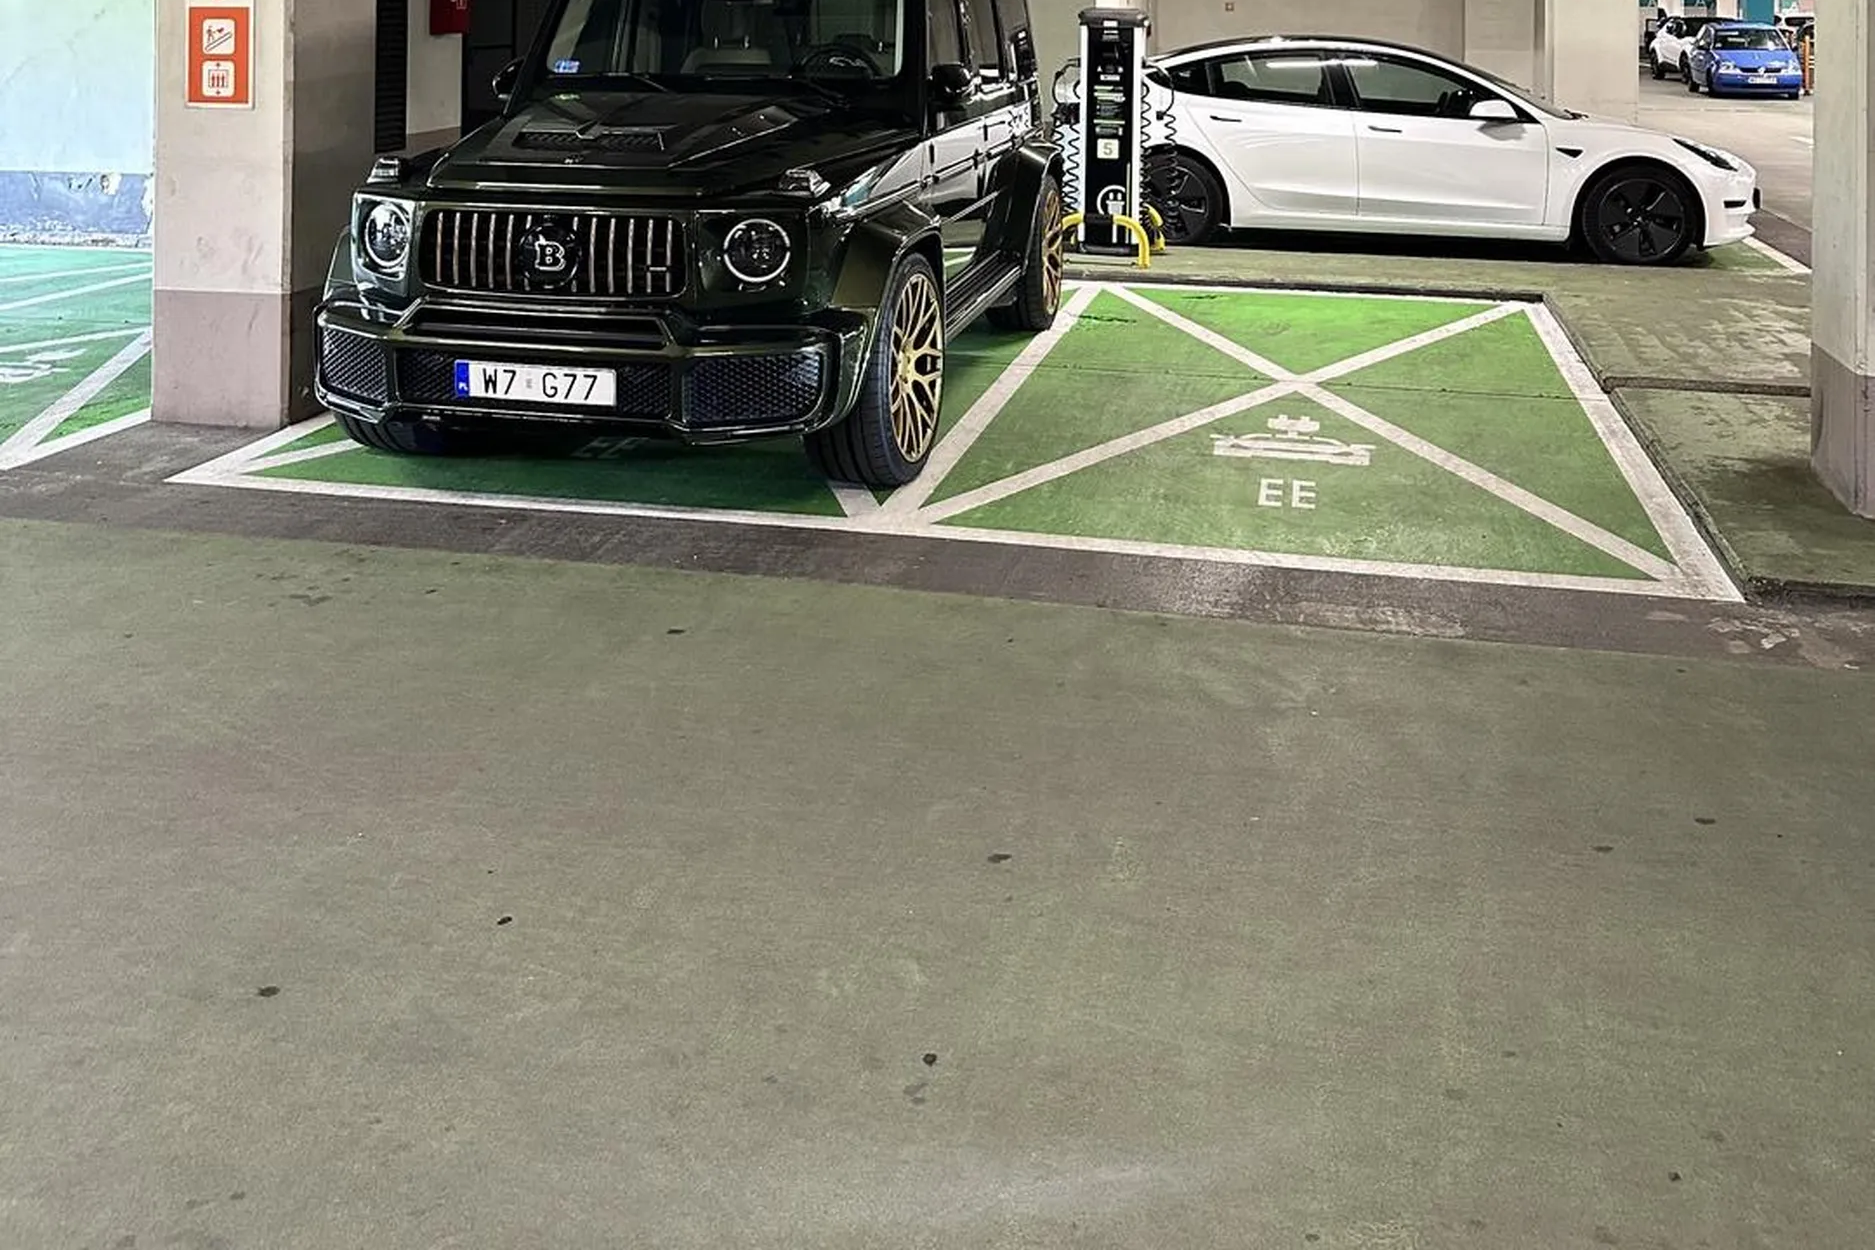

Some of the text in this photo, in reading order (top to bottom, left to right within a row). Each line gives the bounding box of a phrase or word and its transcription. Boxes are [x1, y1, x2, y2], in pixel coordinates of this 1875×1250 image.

[1103, 141, 1113, 156] 5
[483, 368, 598, 401] W7 G77
[1258, 478, 1317, 510] EE
